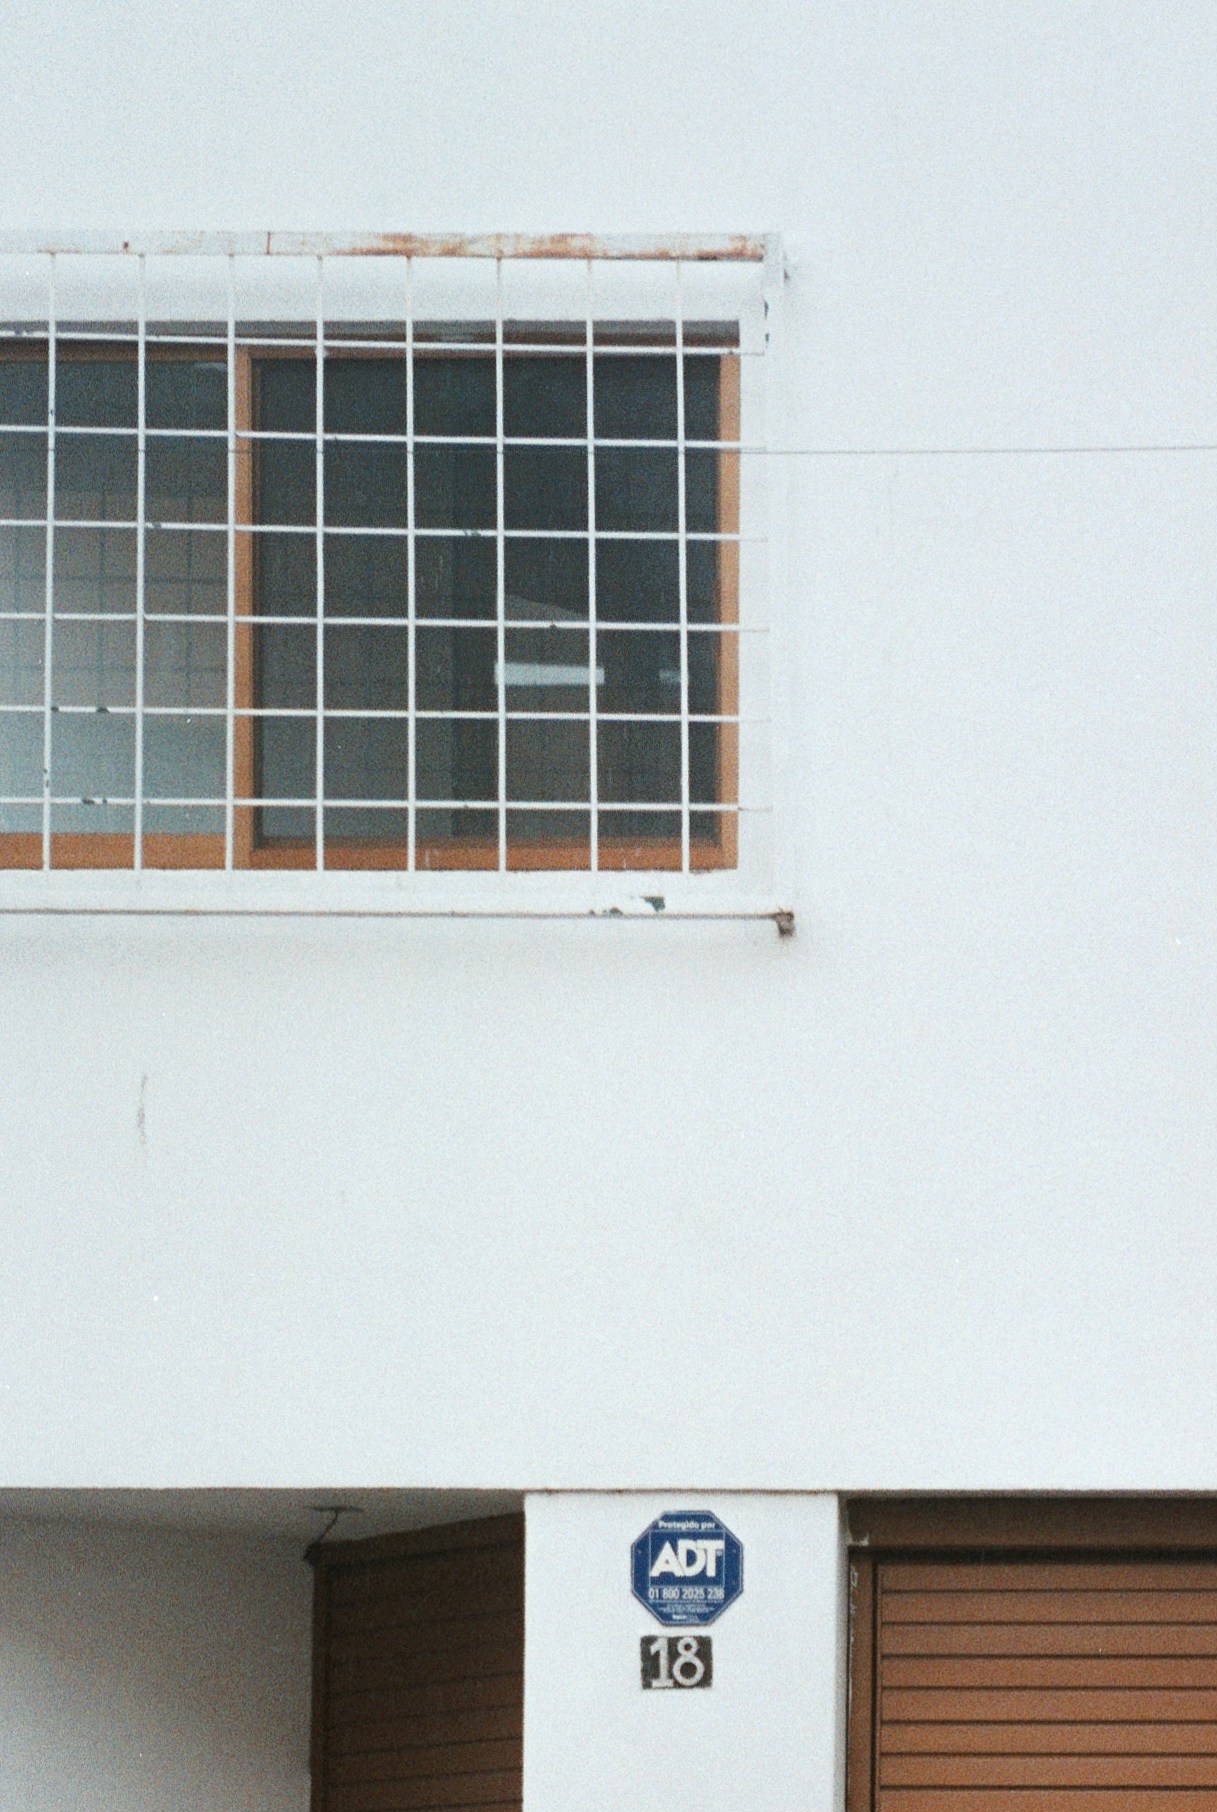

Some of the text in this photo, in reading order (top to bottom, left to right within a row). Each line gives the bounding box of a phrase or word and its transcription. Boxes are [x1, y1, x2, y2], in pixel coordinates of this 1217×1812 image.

[658, 1520, 715, 1531] Protegido por
[650, 1538, 724, 1577] ADT
[648, 1587, 659, 1600] 01
[662, 1587, 680, 1600] 800
[682, 1587, 705, 1600] 2025
[650, 1636, 704, 1687] 18
